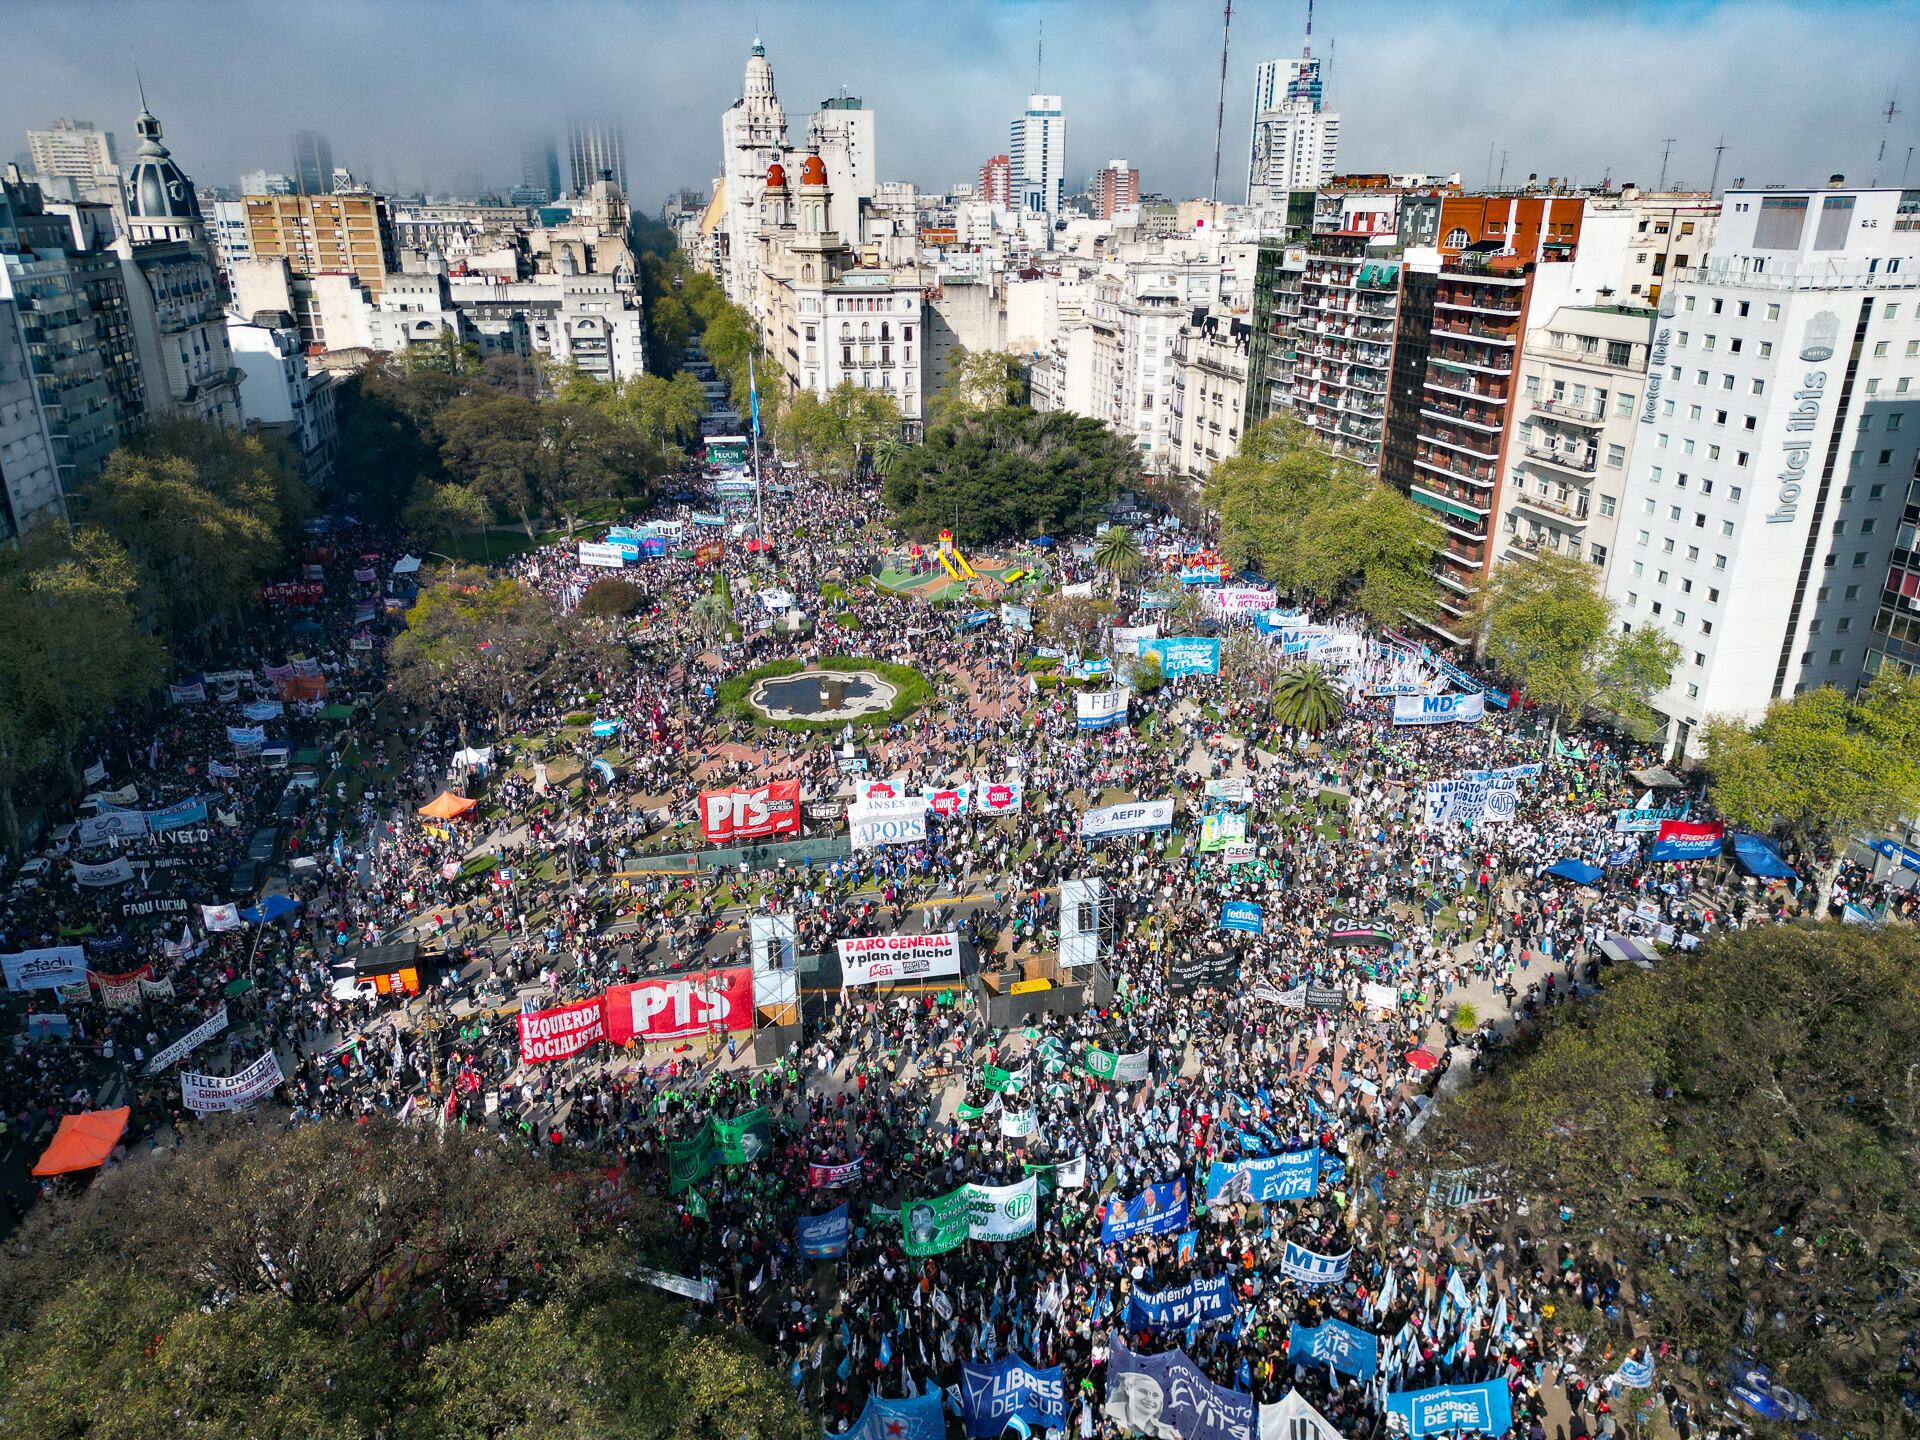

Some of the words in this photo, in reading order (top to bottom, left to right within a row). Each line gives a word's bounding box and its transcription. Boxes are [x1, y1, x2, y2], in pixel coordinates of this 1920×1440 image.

[1806, 350, 1828, 358] HOTEL
[1640, 372, 1663, 424] hotel
[1652, 328, 1670, 365] ibis
[1787, 370, 1827, 432] ibis
[1766, 440, 1811, 524] hotel
[1166, 658, 1212, 670] FUTURO
[1167, 651, 1201, 660] PATRIA
[1375, 685, 1416, 693] LEALTAD
[1091, 692, 1119, 710] FEB
[1431, 714, 1457, 722] DERECHO
[1428, 781, 1480, 793] SINDICATO
[1485, 780, 1515, 791] SALUD
[936, 797, 955, 808] COOKE
[991, 792, 1008, 801] COOKE
[707, 789, 771, 831] PTS
[866, 801, 906, 810] ANSES
[1111, 809, 1145, 821] AEFIP
[1228, 846, 1254, 856] CECS
[122, 901, 153, 917] FADU
[155, 898, 188, 911] LUCHA
[845, 938, 886, 952] PARO
[888, 936, 951, 950] GENERAL
[846, 956, 855, 968] y
[857, 951, 889, 968] plan
[892, 951, 910, 960] de
[912, 948, 953, 959] lucha
[870, 965, 893, 976] MST
[630, 975, 731, 1033] PTS
[522, 1004, 601, 1040] IZQUIERDA
[524, 1026, 604, 1060] SOCIALISTA
[183, 1054, 273, 1088] TELEFONICOS
[830, 1165, 861, 1174] MTL
[1264, 1167, 1313, 1183] movimiento
[1007, 1196, 1032, 1218] ATE
[1111, 1224, 1125, 1232] ACA
[1126, 1222, 1136, 1230] NO
[1146, 1212, 1165, 1224] RINDE
[978, 1232, 1005, 1241] CAPITAL
[1286, 1243, 1349, 1274] MTE
[1148, 1309, 1170, 1325] LA
[1172, 1293, 1222, 1322] PLATA
[992, 1367, 1064, 1399] LIBRES
[1168, 1364, 1252, 1418] movimiento
[991, 1393, 1025, 1418] DEL
[1028, 1391, 1064, 1416] SUR
[1424, 1401, 1478, 1415] BARRIOS
[1424, 1414, 1448, 1426] DE
[1451, 1412, 1480, 1424] PIE
